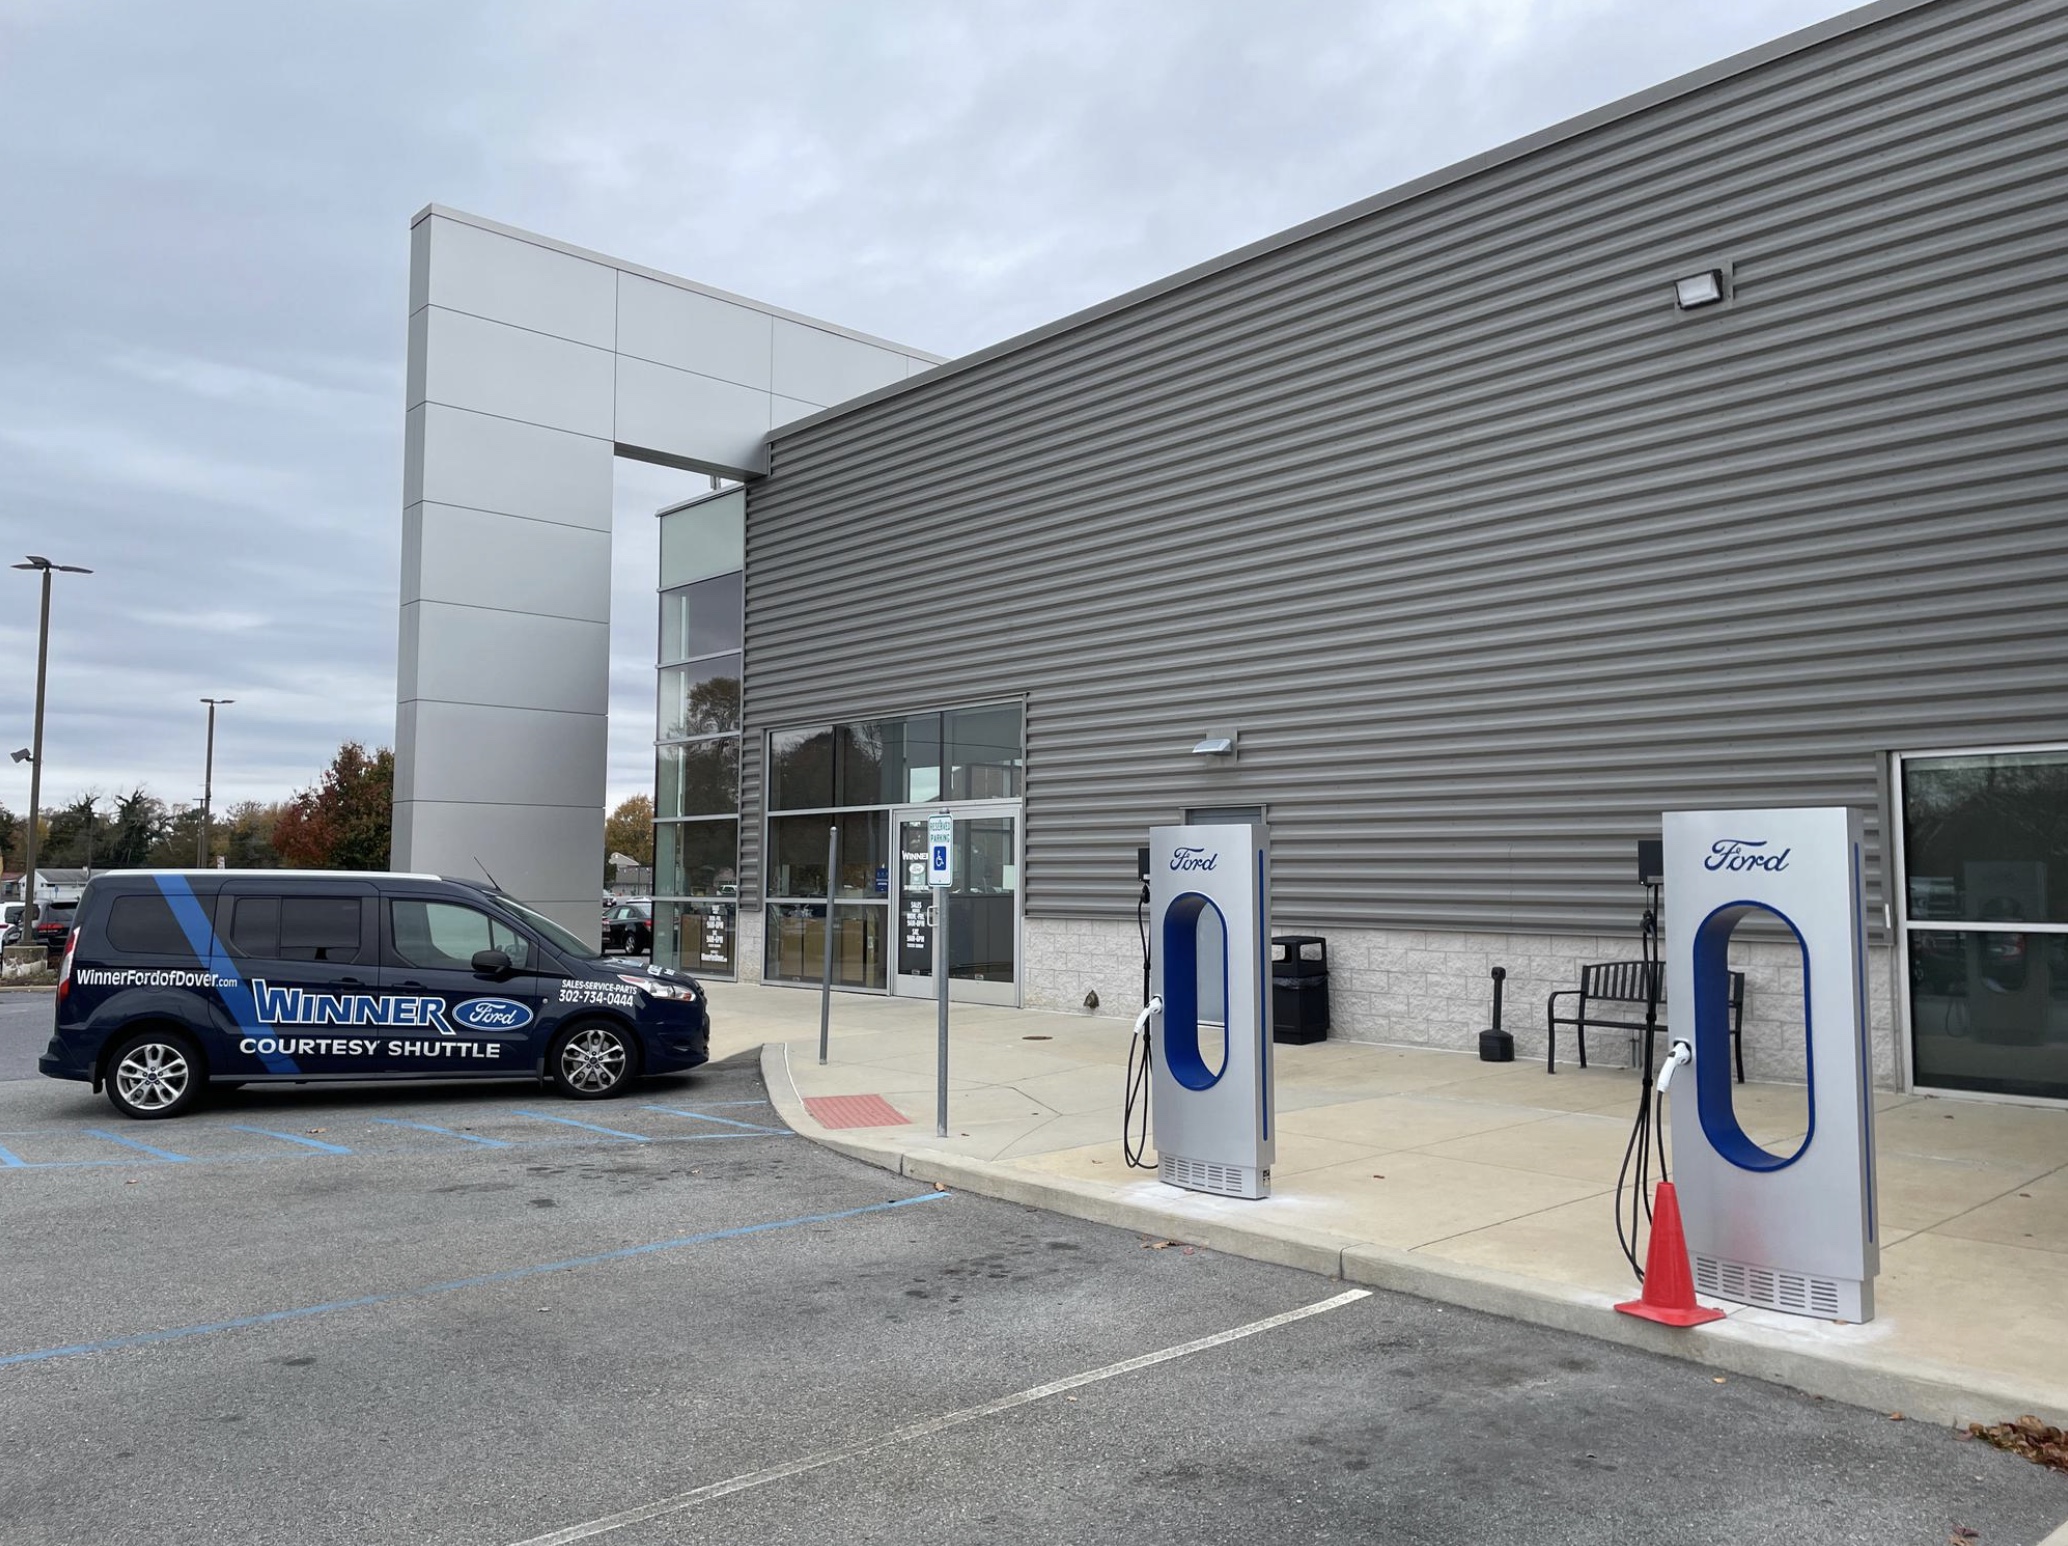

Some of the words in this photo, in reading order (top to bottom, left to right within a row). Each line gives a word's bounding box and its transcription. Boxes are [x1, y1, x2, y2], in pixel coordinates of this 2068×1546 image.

[931, 833, 950, 843] PARKING
[1170, 847, 1218, 871] Ford
[1704, 839, 1791, 871] Ford
[77, 969, 238, 988] WinnerFordofDover.com
[251, 978, 457, 1035] WINNER
[469, 1001, 516, 1025] Ford
[558, 989, 634, 1007] 302-734-0444
[239, 1038, 377, 1056] COURTESY
[388, 1040, 500, 1058] SHUTTLE
